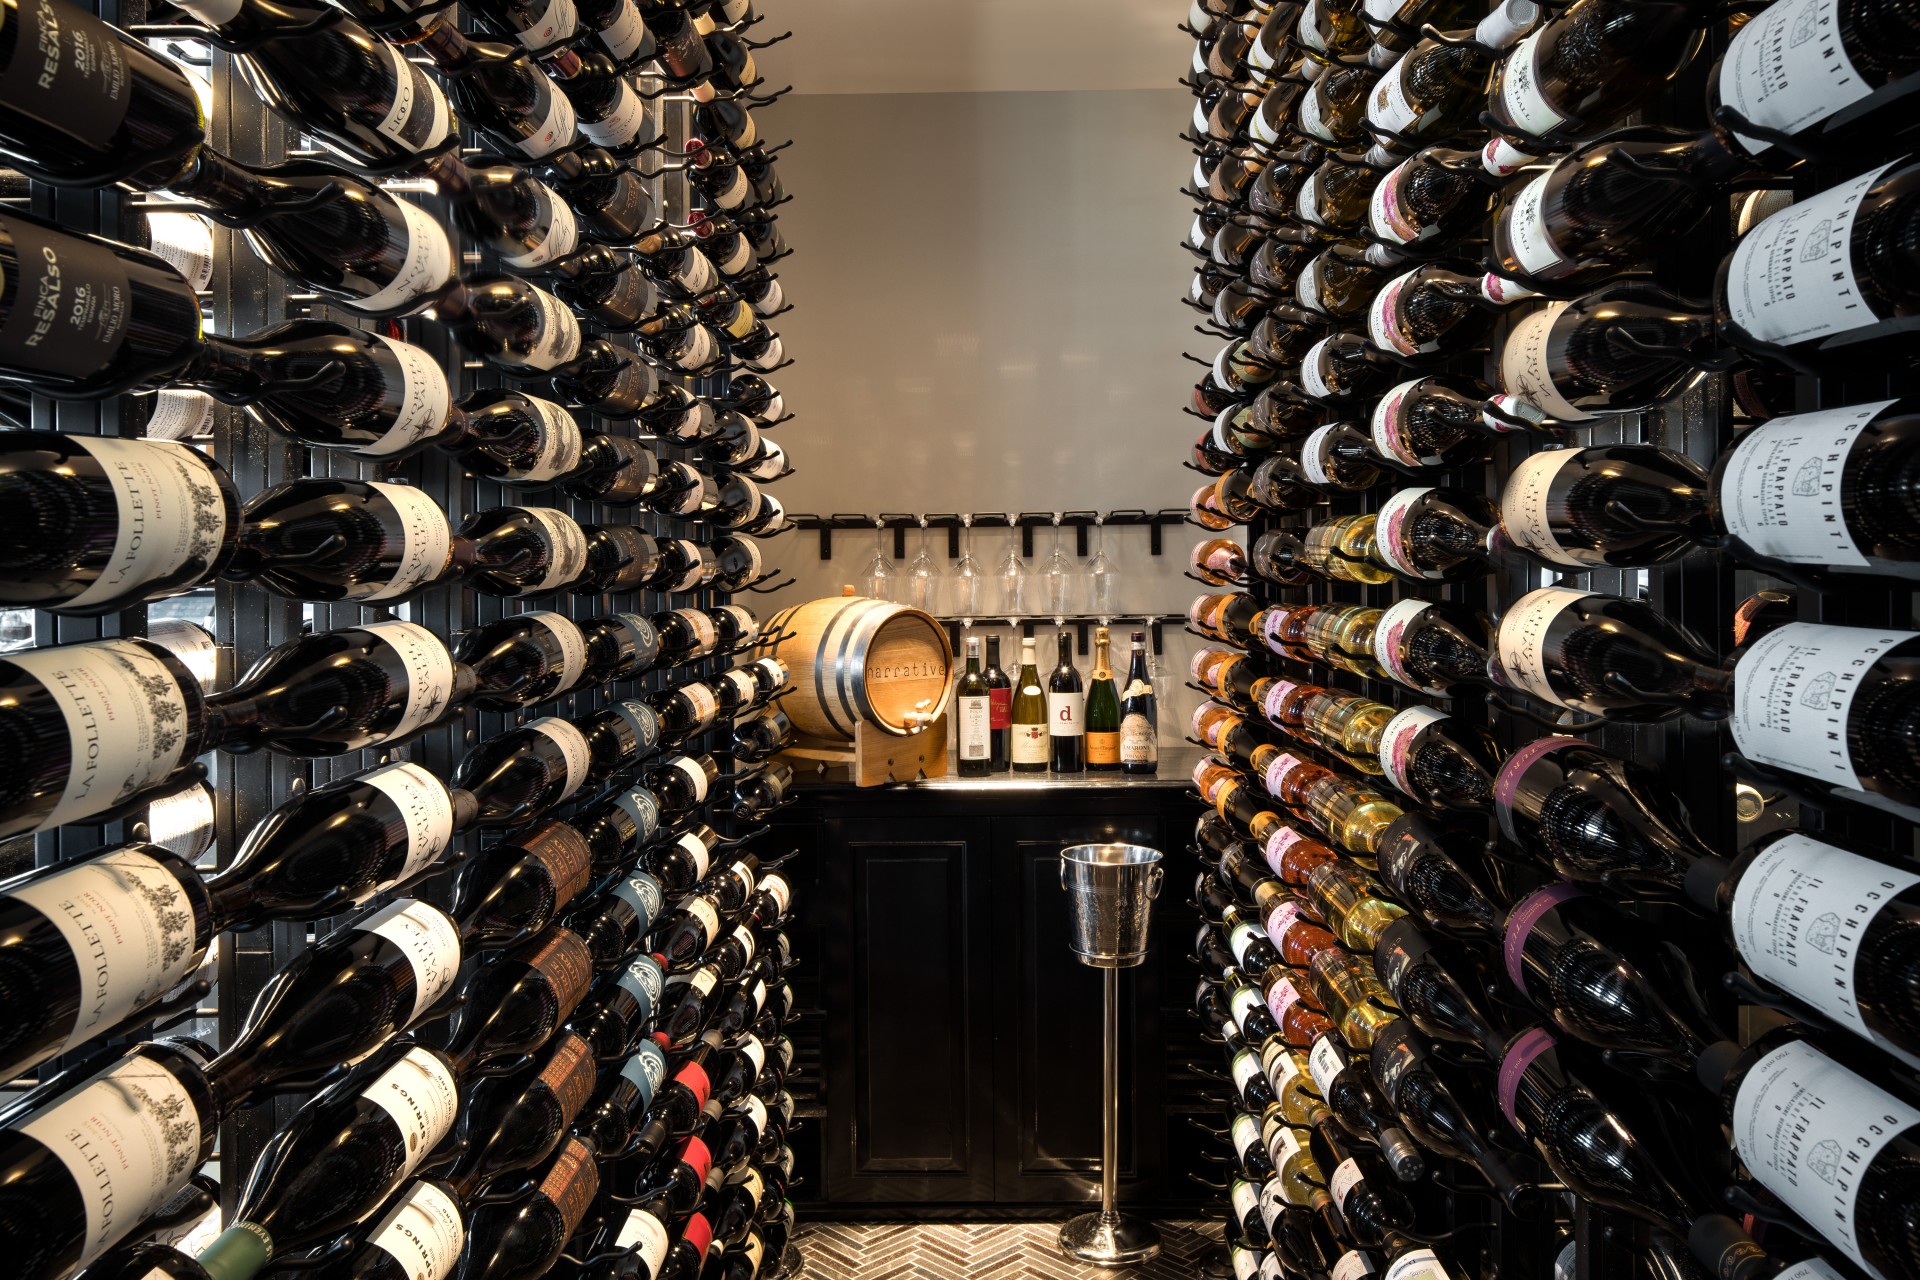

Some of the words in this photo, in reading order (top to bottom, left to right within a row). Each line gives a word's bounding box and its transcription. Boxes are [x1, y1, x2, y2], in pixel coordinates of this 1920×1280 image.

[37, 10, 48, 53] FINCA
[72, 29, 86, 71] 2016
[1514, 90, 1530, 121] HALL
[1519, 221, 1530, 253] HALL
[1782, 229, 1799, 300] FRAPPATO
[1830, 169, 1881, 310] OCCHIPINTI
[25, 246, 61, 346] RESALSO
[33, 275, 49, 318] FINCA
[70, 285, 86, 326] 2016
[102, 315, 119, 343] EMILIO
[112, 286, 120, 313] MORO
[113, 460, 145, 561] FOLLETTE
[150, 485, 162, 520] PINOT
[1525, 468, 1545, 535] VALLEY
[1774, 457, 1792, 527] FRAPPATO
[1821, 412, 1871, 549] OCCHIPINTI
[409, 502, 428, 569] VALLEY
[1531, 490, 1559, 555] NORTH
[108, 563, 133, 586] LA
[392, 524, 420, 589] NORTH
[1522, 598, 1557, 660] VALLEY
[1529, 616, 1543, 686] NORTH
[77, 667, 104, 691] NOIR
[398, 632, 430, 693] VALLEY
[408, 649, 424, 719] NORTH
[867, 662, 946, 679] narrative
[52, 670, 100, 772] FOLLETTE
[98, 692, 115, 722] PINOT
[1060, 706, 1072, 721] d
[1780, 664, 1805, 734] FRAPPATO
[1827, 638, 1894, 771] OCCHIPINTI
[75, 774, 96, 800] LA
[1501, 748, 1537, 800] TURLEY
[402, 784, 430, 848] VALLEY
[405, 803, 424, 873] NORTH
[83, 892, 104, 913] NOIR
[104, 917, 124, 945] PINOT
[1785, 897, 1809, 968] FRAPPATO
[59, 900, 110, 1000] FOLLETTE
[401, 923, 438, 983] VALLEY
[413, 942, 431, 1008] NORTH
[1834, 881, 1896, 1018] OCCHIPINTI
[86, 1008, 103, 1030] LA
[90, 1116, 112, 1138] NOIR
[391, 1082, 427, 1141] SPRINGS
[65, 1128, 114, 1227] FOLLETTE
[111, 1140, 129, 1170] PINOT
[1787, 1115, 1810, 1187] FRAPPATO
[1834, 1114, 1899, 1252] OCCHIPINTI
[232, 1222, 270, 1244] EVENING
[396, 1222, 433, 1279] SPRINGS
